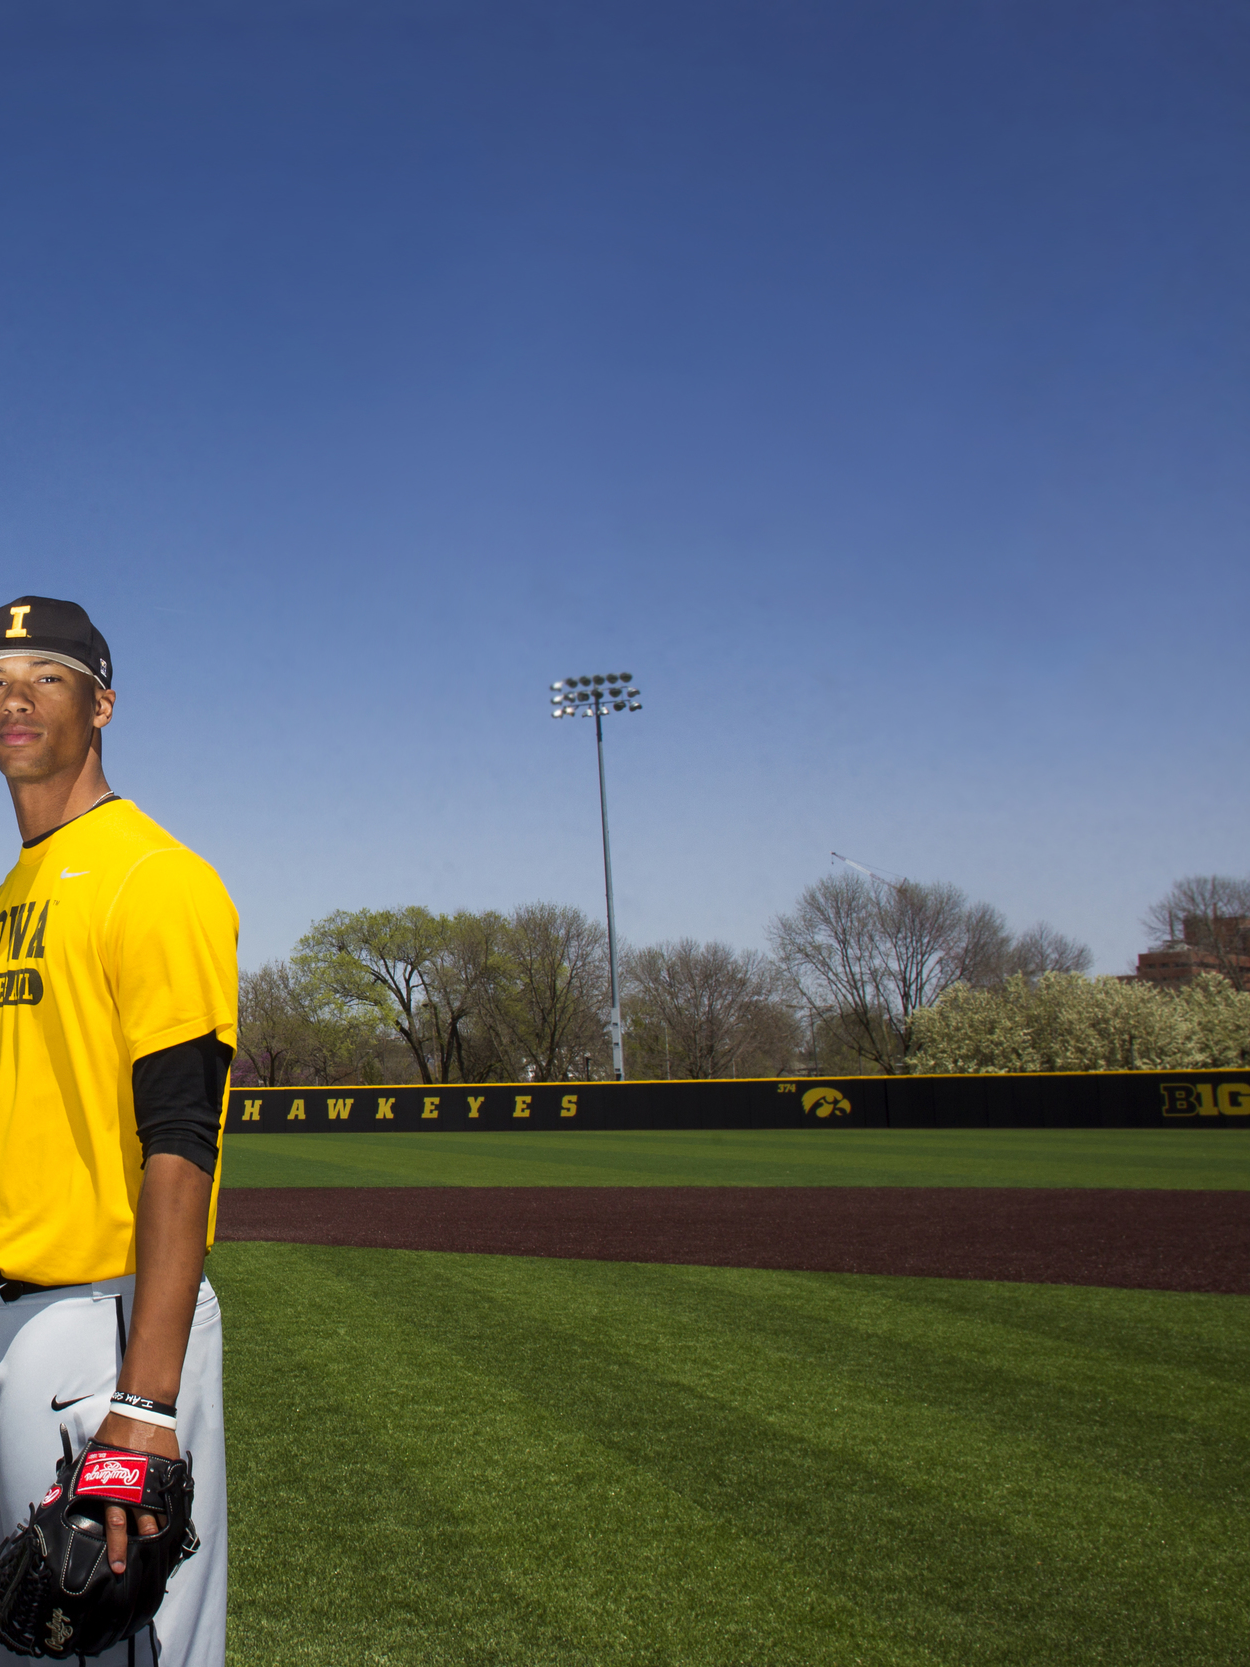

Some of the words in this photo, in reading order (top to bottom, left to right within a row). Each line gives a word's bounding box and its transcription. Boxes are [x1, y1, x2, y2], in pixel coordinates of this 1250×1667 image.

[5, 605, 31, 638] I
[777, 1083, 797, 1093] 374
[242, 1095, 578, 1121] HAWKEYES
[125, 1393, 142, 1406] AM
[84, 1464, 140, 1486] Rawlings
